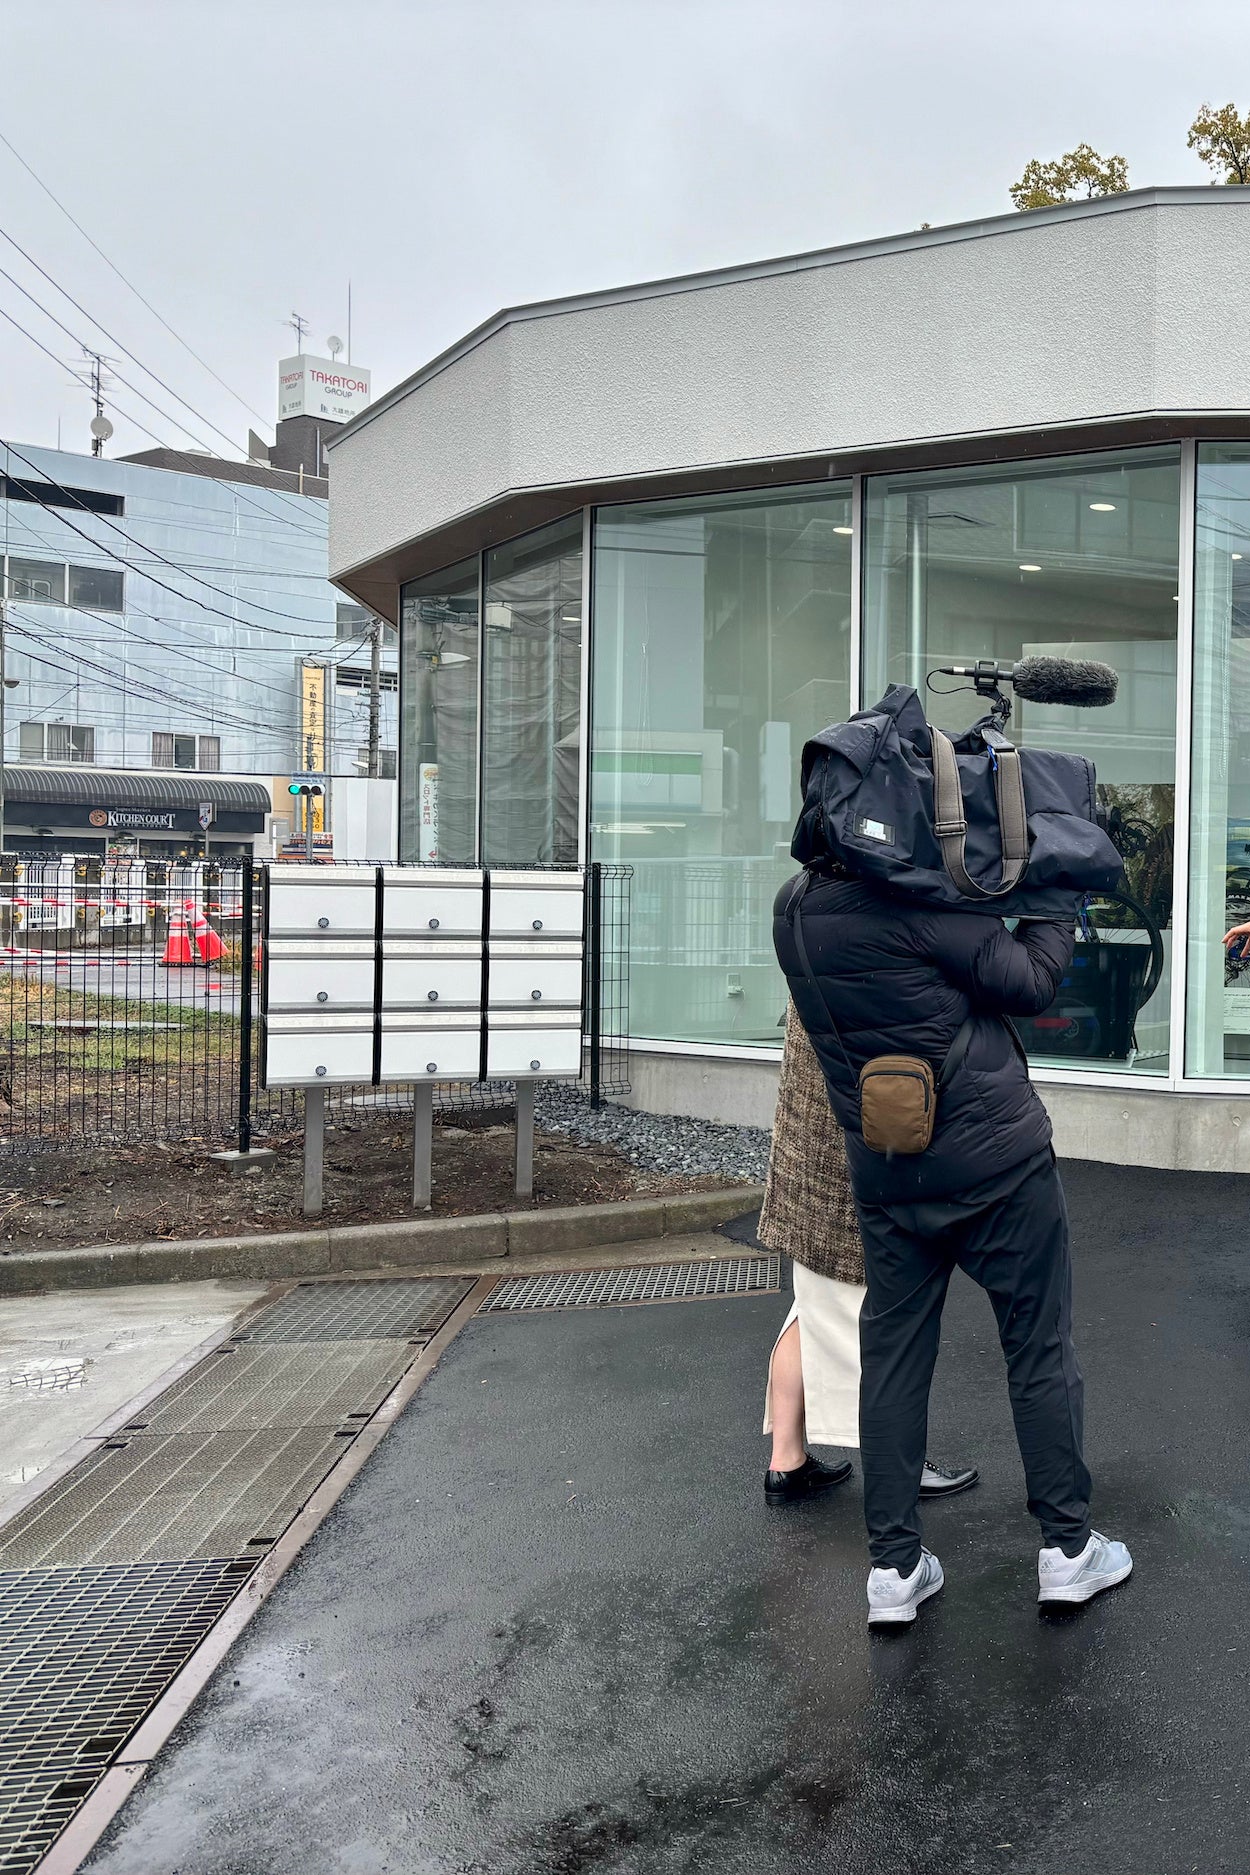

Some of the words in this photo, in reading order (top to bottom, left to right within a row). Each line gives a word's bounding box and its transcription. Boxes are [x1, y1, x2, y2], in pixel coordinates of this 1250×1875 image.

[309, 369, 368, 394] TAKATORI
[325, 387, 353, 399] GROUP
[107, 811, 145, 827] KITCHEN
[145, 813, 176, 829] COURT
